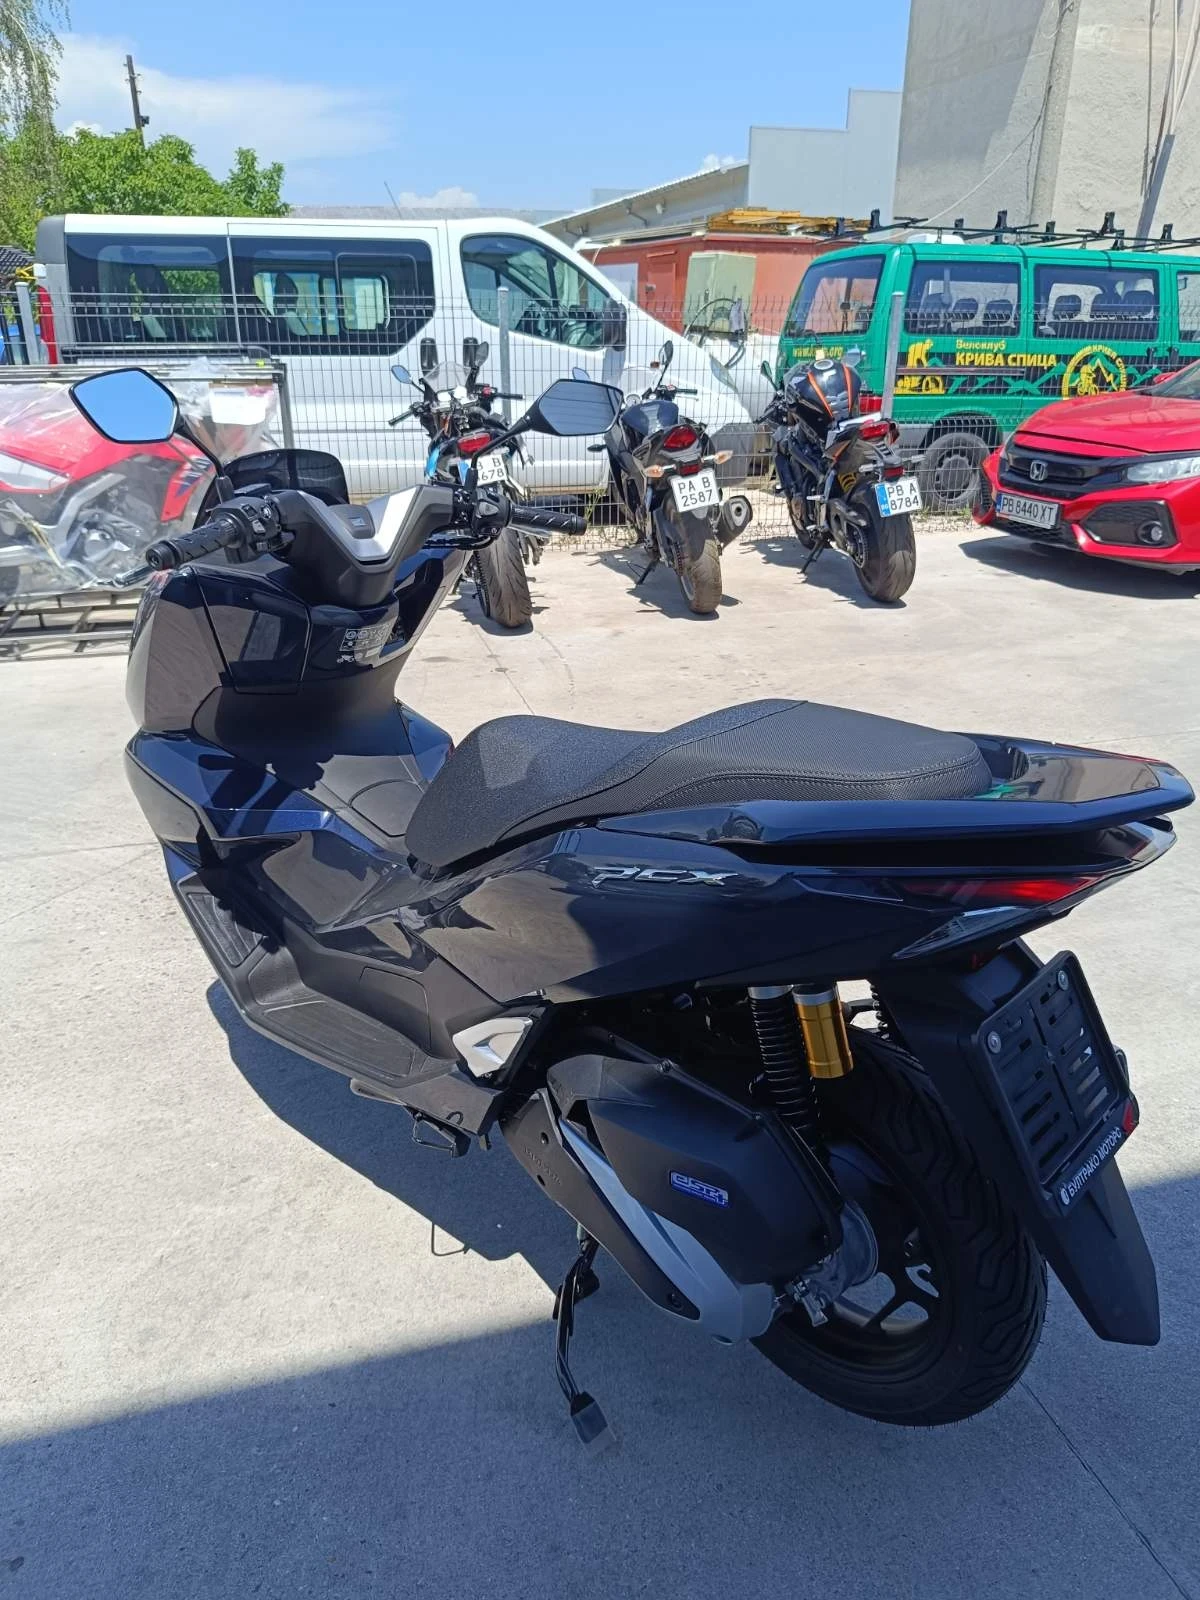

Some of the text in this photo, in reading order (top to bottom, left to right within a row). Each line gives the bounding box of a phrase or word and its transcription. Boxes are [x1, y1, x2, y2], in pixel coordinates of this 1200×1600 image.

[956, 352, 1057, 370] КРИВА СПИЦА
[478, 468, 505, 481] 678
[678, 476, 711, 494] PA B
[887, 482, 918, 499] PB A
[681, 488, 713, 507] 2587
[890, 495, 920, 511] 8784
[1001, 497, 1054, 521] PB 8440 XT
[591, 866, 739, 889] PCX
[1067, 1126, 1122, 1198] БУЛТРАКО МОТОРС
